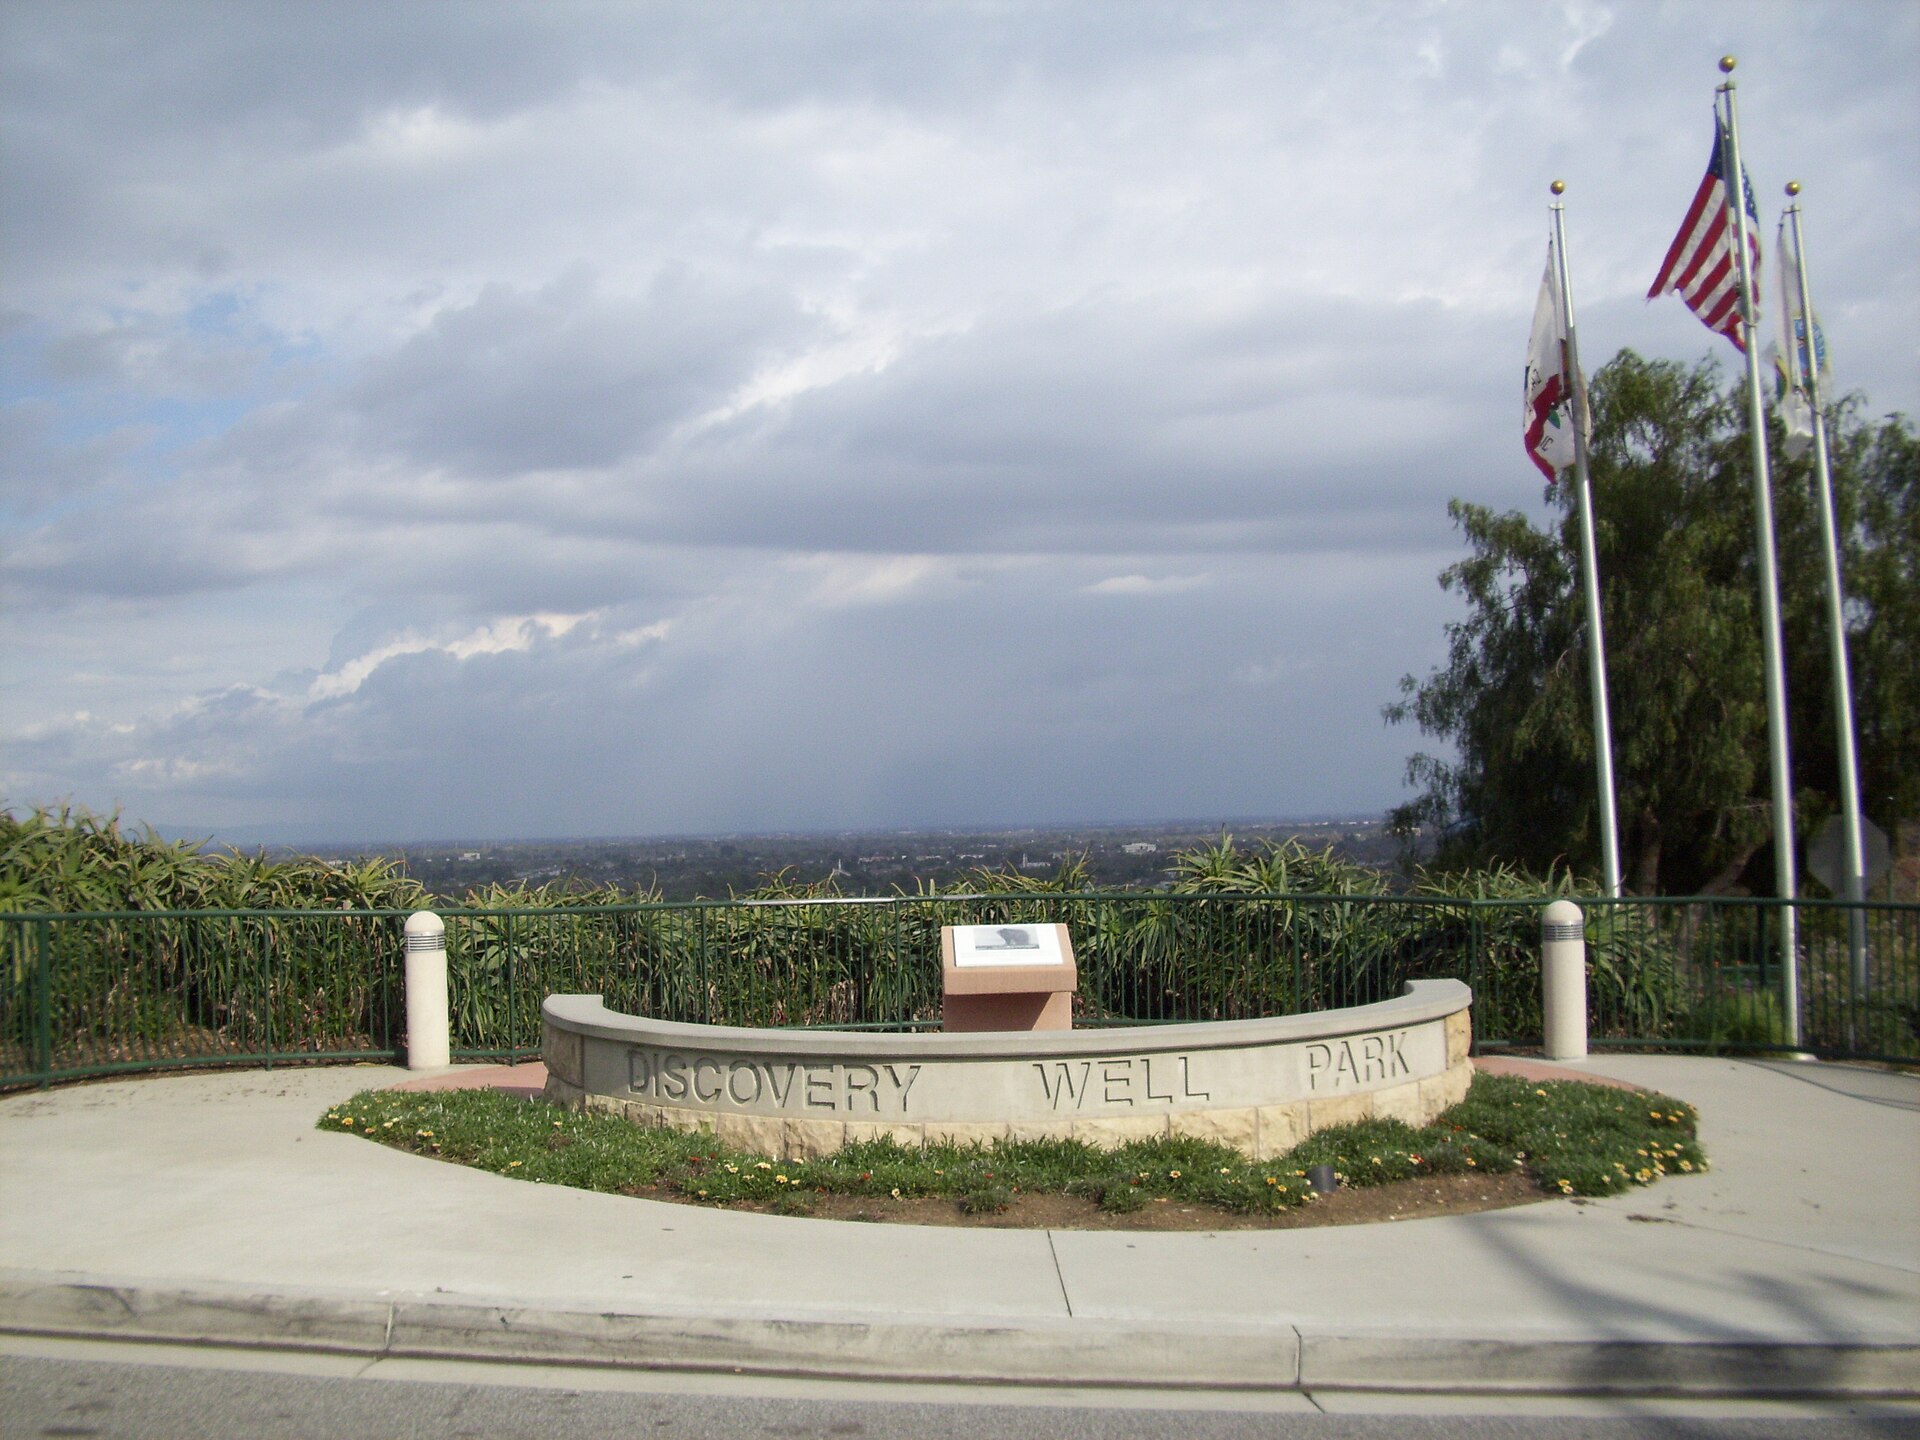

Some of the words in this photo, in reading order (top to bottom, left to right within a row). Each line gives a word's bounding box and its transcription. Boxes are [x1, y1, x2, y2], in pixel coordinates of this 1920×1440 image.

[628, 1049, 921, 1113] DISCOVERY
[1032, 1056, 1210, 1110] WELL
[1305, 1032, 1411, 1090] PARK
